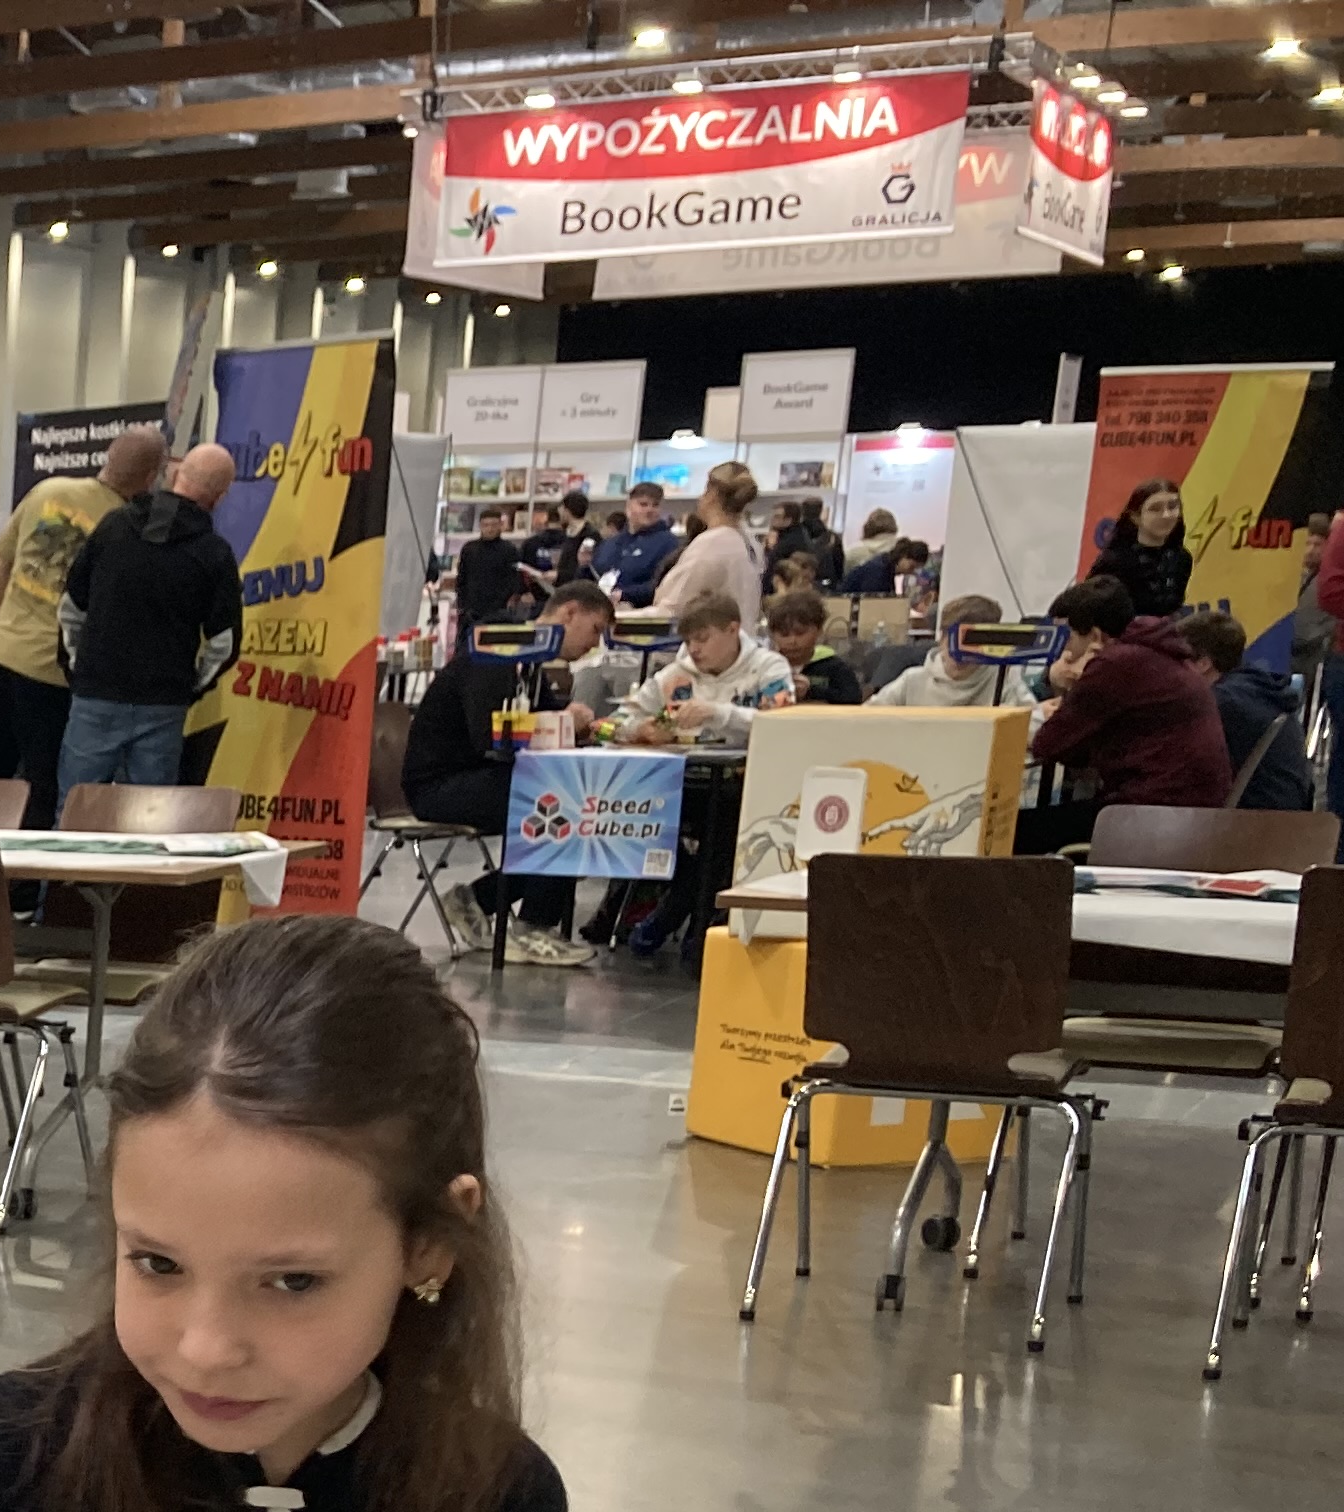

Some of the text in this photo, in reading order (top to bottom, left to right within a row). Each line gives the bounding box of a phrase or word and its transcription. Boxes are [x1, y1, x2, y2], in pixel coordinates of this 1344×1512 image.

[503, 94, 899, 168] WYPOŻYCZALNIA
[559, 189, 803, 237] BookGame
[851, 209, 943, 228] GRALICJA
[242, 555, 326, 607] ENUJ
[240, 618, 328, 657] AZEM
[232, 660, 356, 721] Z NAMI!
[581, 795, 653, 816] Speed
[577, 818, 662, 840] Cube.pl
